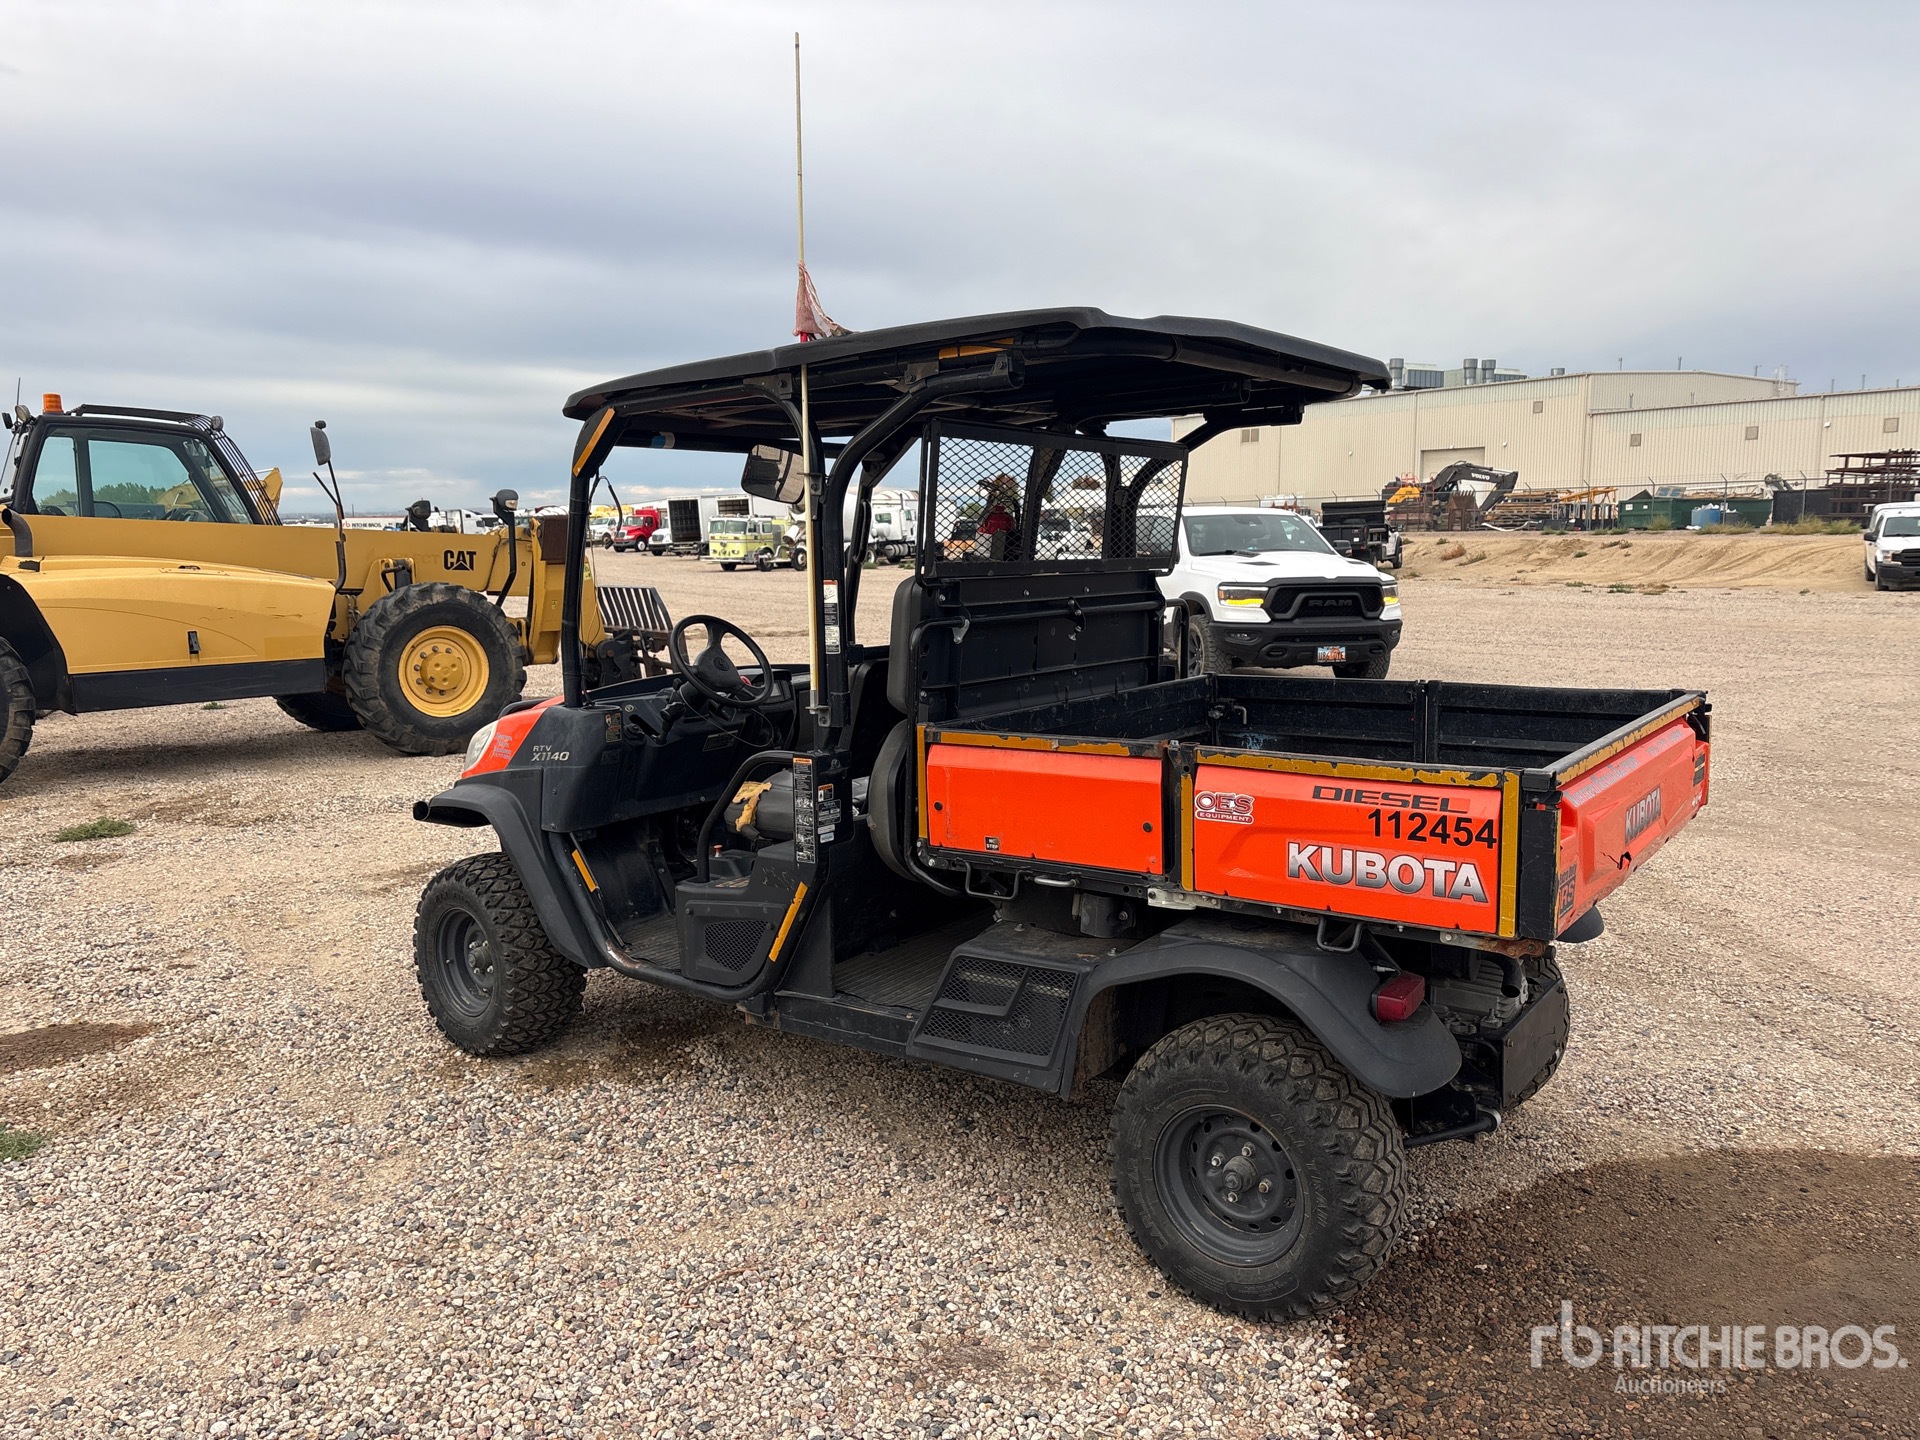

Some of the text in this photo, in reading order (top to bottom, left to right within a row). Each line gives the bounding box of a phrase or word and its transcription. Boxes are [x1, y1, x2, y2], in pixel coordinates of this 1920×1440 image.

[1471, 472, 1490, 481] VOLVO
[443, 549, 477, 571] CAT
[1308, 599, 1353, 607] RAM
[531, 751, 570, 762] X1140
[1195, 791, 1255, 815] OES
[1312, 785, 1470, 814] DIESEL
[1198, 811, 1251, 823] EQUIPMENT
[1625, 786, 1661, 845] KUBOTA
[1367, 808, 1497, 849] 112454
[1287, 841, 1489, 904] KUBOTA
